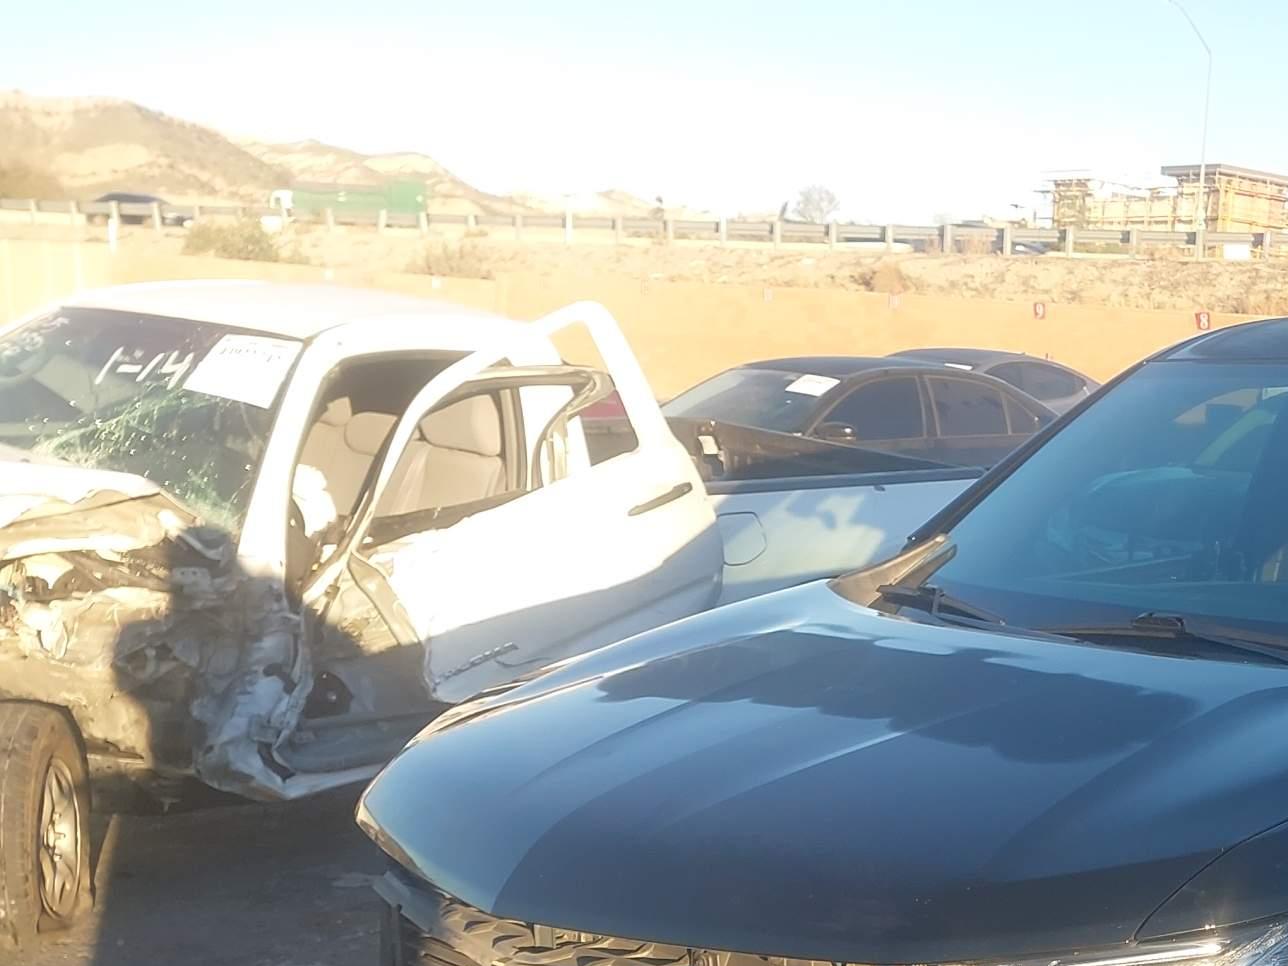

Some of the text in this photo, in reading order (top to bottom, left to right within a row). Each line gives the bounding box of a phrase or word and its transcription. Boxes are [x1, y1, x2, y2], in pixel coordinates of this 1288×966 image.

[1035, 303, 1044, 318] 9
[1199, 313, 1209, 329] 8
[94, 346, 195, 390] 1-14
